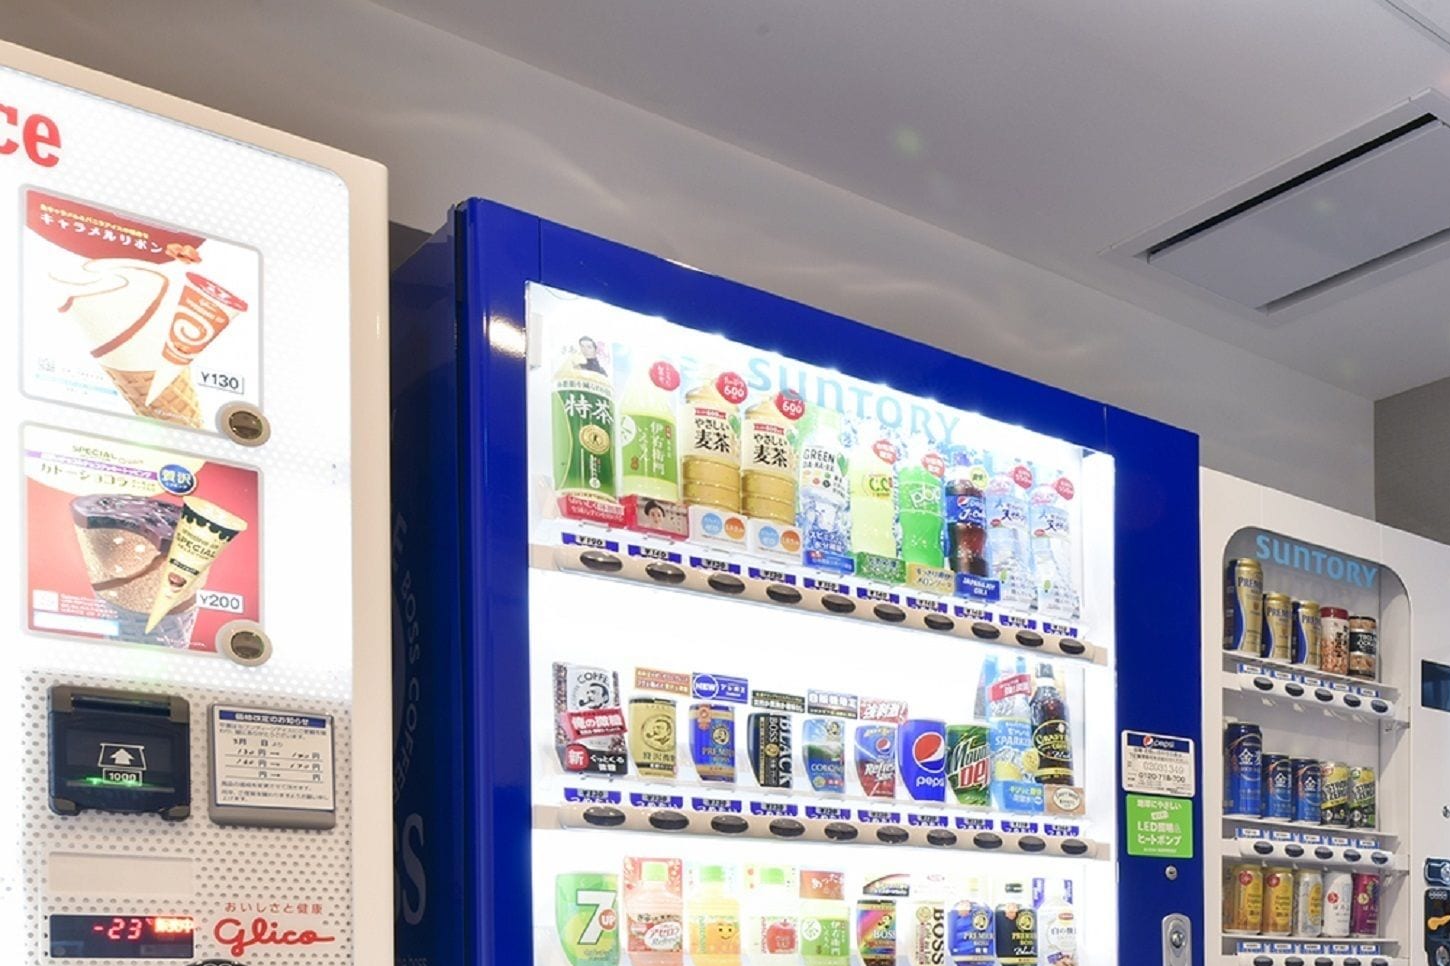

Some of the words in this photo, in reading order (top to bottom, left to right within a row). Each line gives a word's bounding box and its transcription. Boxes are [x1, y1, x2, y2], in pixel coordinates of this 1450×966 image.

[0, 103, 62, 168] ce
[39, 212, 163, 254] キャラメルリボン
[723, 385, 745, 398] 600
[747, 357, 961, 446] SUNTORY
[564, 393, 616, 425] 特茶
[782, 400, 803, 414] 600
[694, 418, 730, 431] やさしい
[694, 429, 730, 454] 麦茶
[753, 433, 788, 447] やさしい
[753, 444, 788, 468] 麦茶
[803, 448, 836, 464] GREEN
[176, 532, 217, 559] SPECIAL
[1254, 533, 1378, 589] SUNTORY
[695, 681, 717, 692] NEW
[769, 715, 778, 743] BOSS
[567, 748, 585, 766] 新
[778, 714, 793, 786] BLACK
[107, 771, 138, 783] 1000
[916, 775, 945, 788] peps
[224, 902, 324, 915] おいしさと健康
[576, 888, 618, 946] 7
[600, 914, 617, 925] UP
[213, 917, 335, 958] Glico
[931, 907, 945, 966] BOSS
